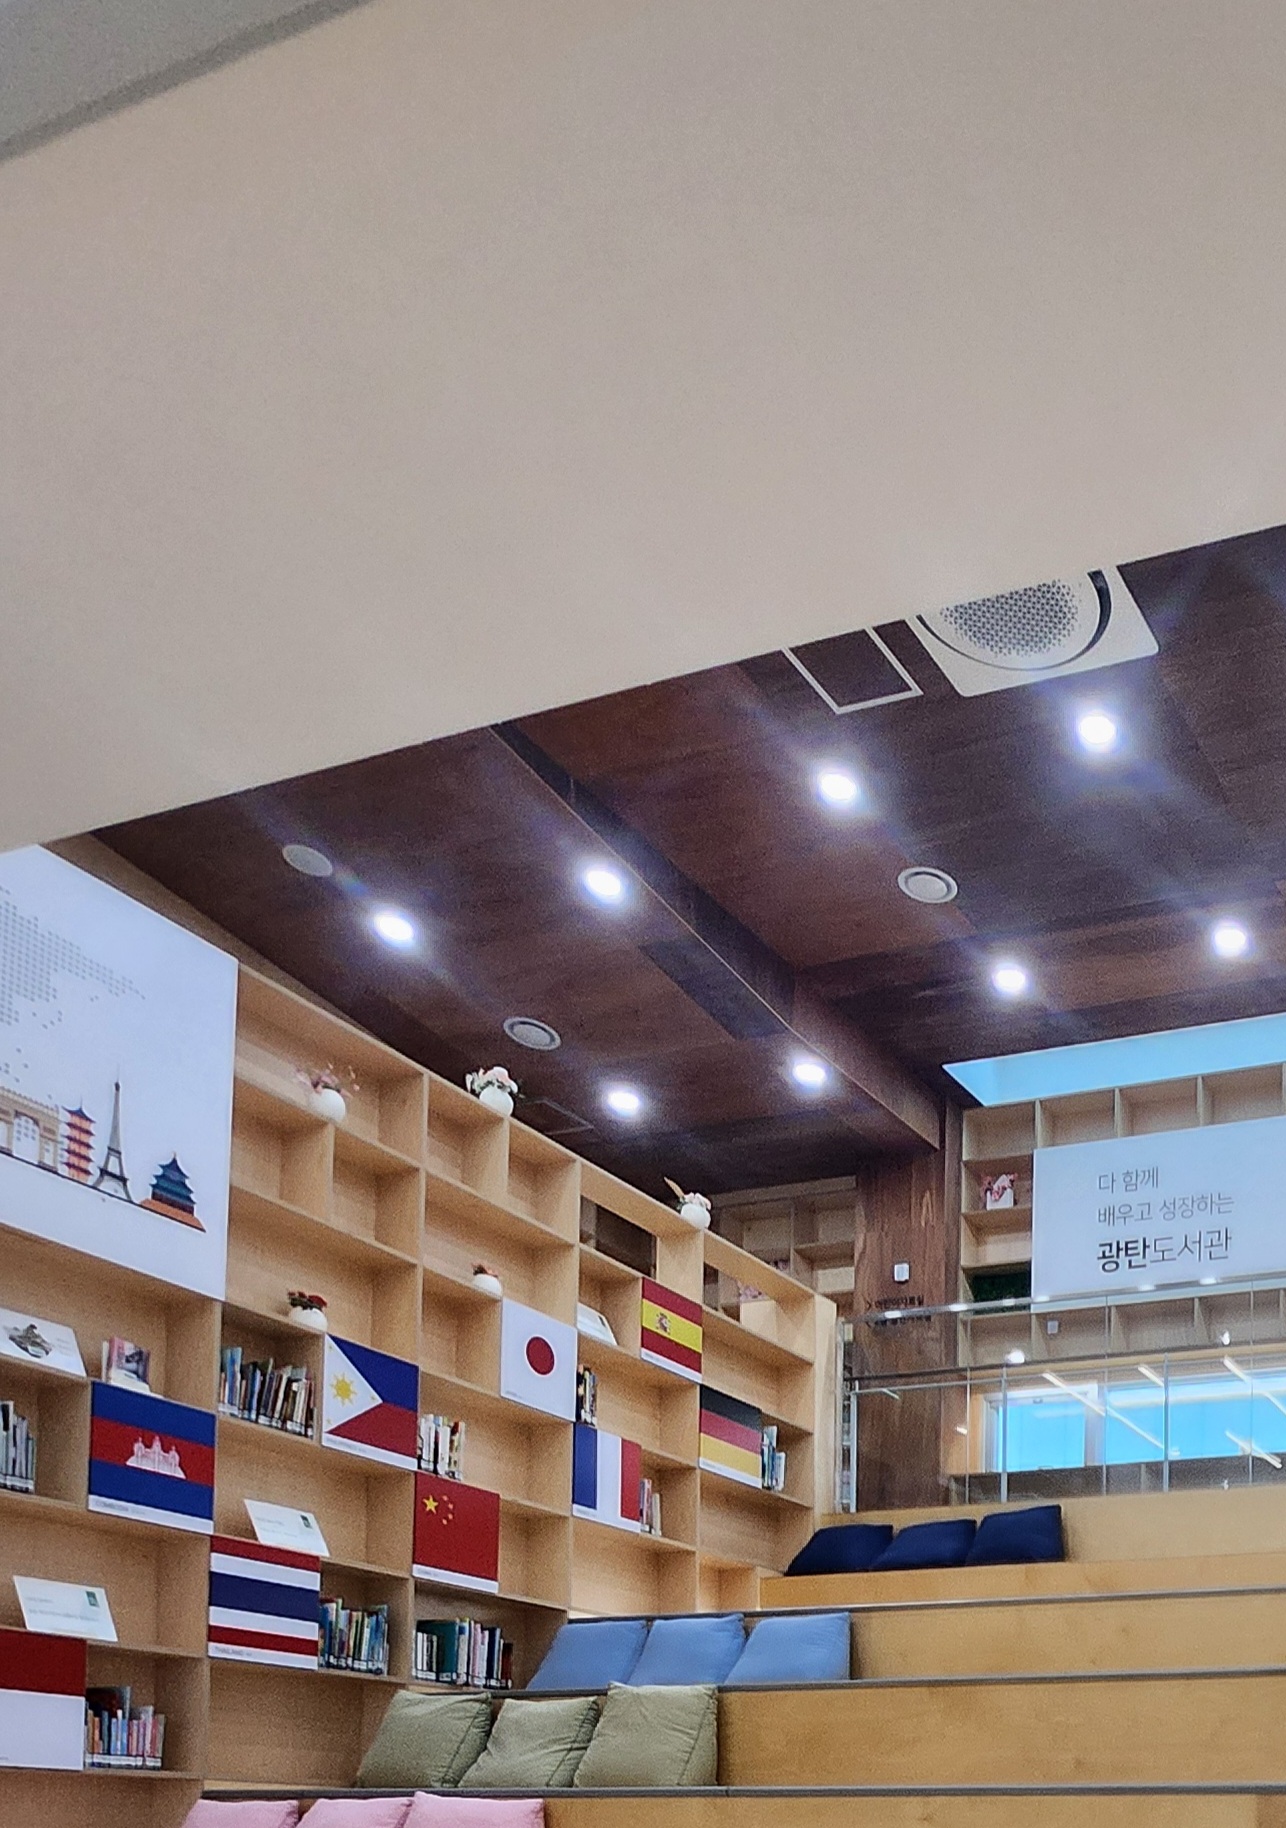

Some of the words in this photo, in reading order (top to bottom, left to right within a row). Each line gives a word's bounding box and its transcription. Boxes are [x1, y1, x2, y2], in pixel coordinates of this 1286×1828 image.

[1098, 1172, 1117, 1194] 다
[1122, 1166, 1159, 1193] 함께
[1098, 1202, 1153, 1226] 배우고
[1159, 1192, 1235, 1221] 성장하는
[1097, 1227, 1232, 1273] 광탄도서관
